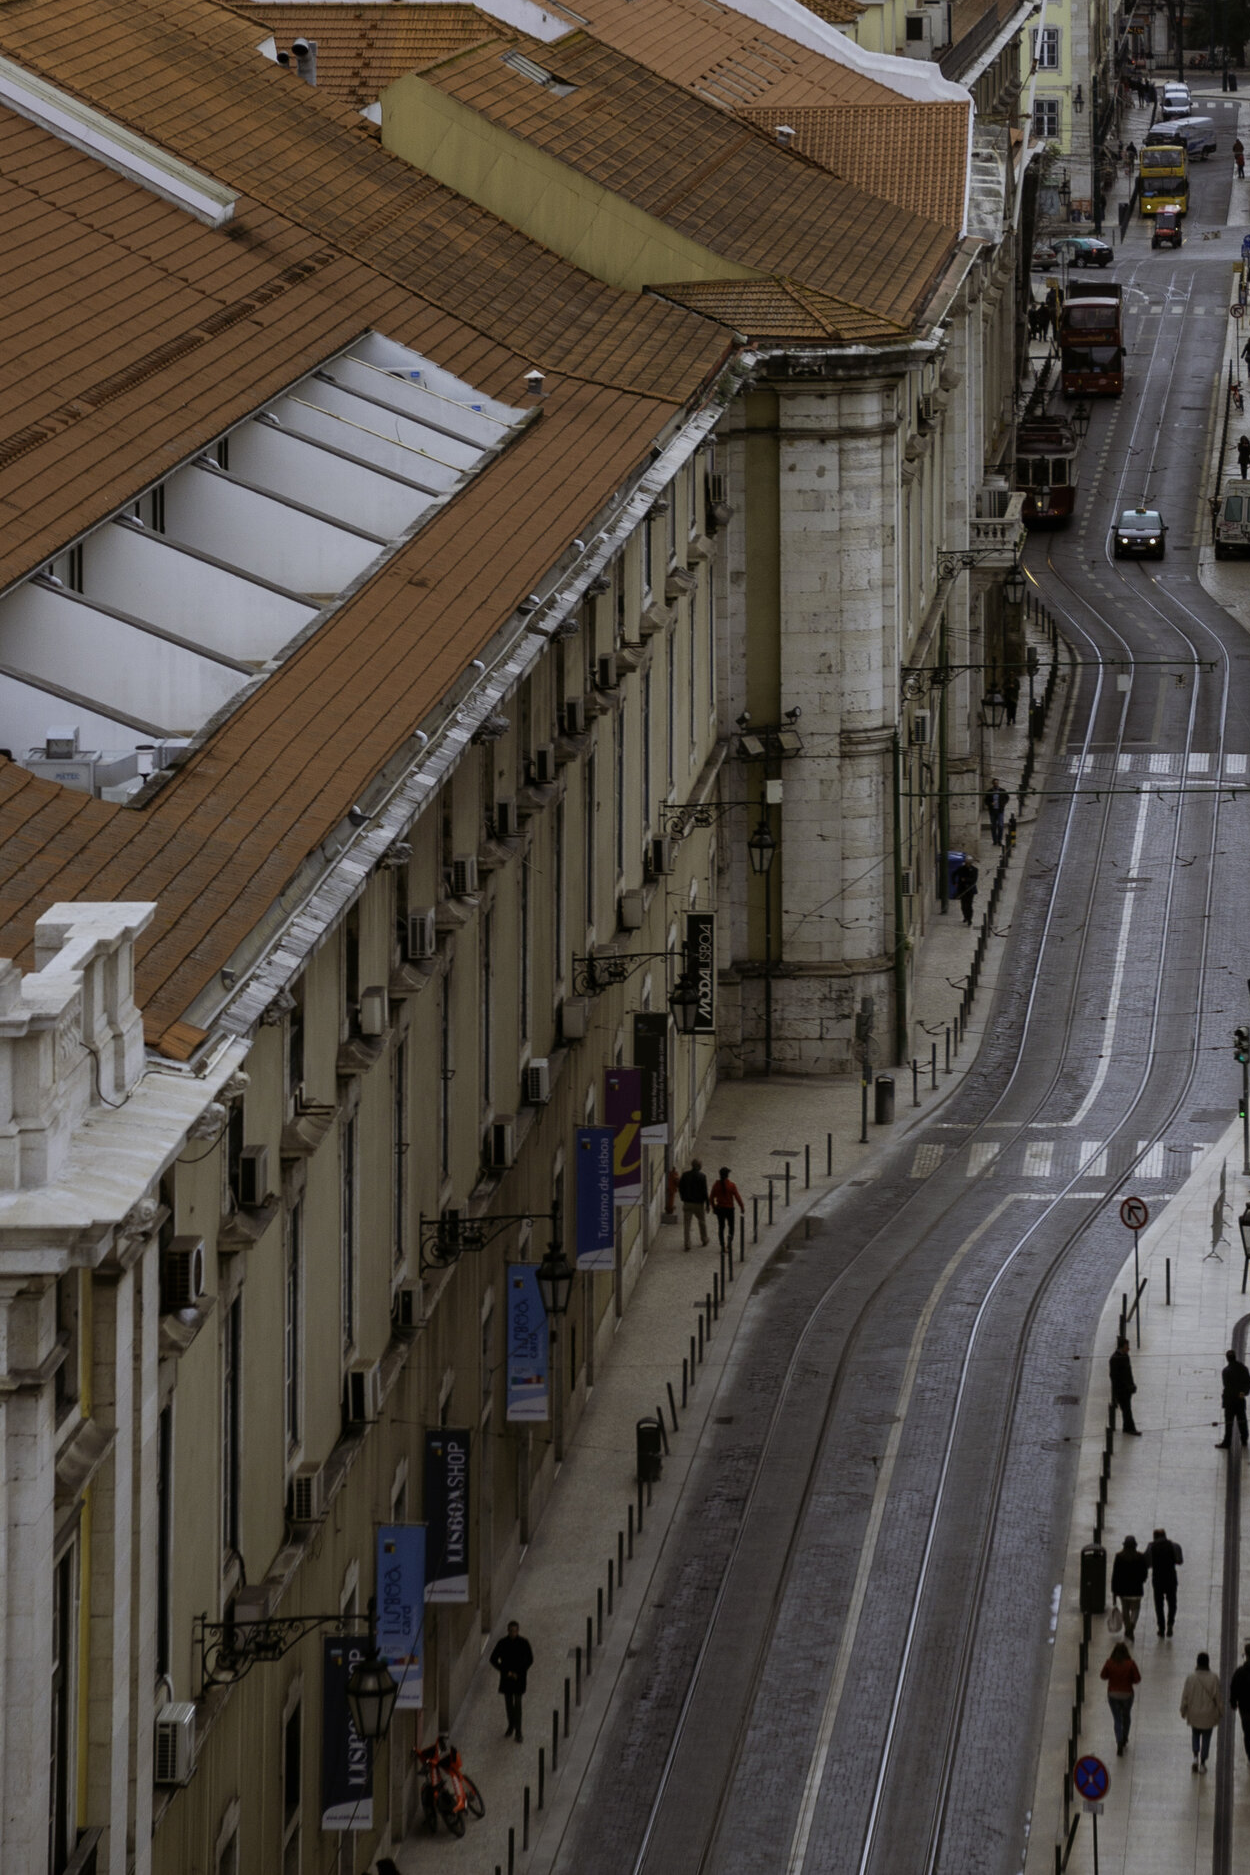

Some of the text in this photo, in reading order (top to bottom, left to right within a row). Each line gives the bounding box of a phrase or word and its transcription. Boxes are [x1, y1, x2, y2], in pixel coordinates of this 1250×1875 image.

[698, 924, 711, 1019] MODALISBOA
[598, 1137, 609, 1239] Turismo de Lisboa
[528, 1333, 538, 1359] card
[446, 1441, 465, 1563] LISBOASHOP
[400, 1605, 412, 1636] card
